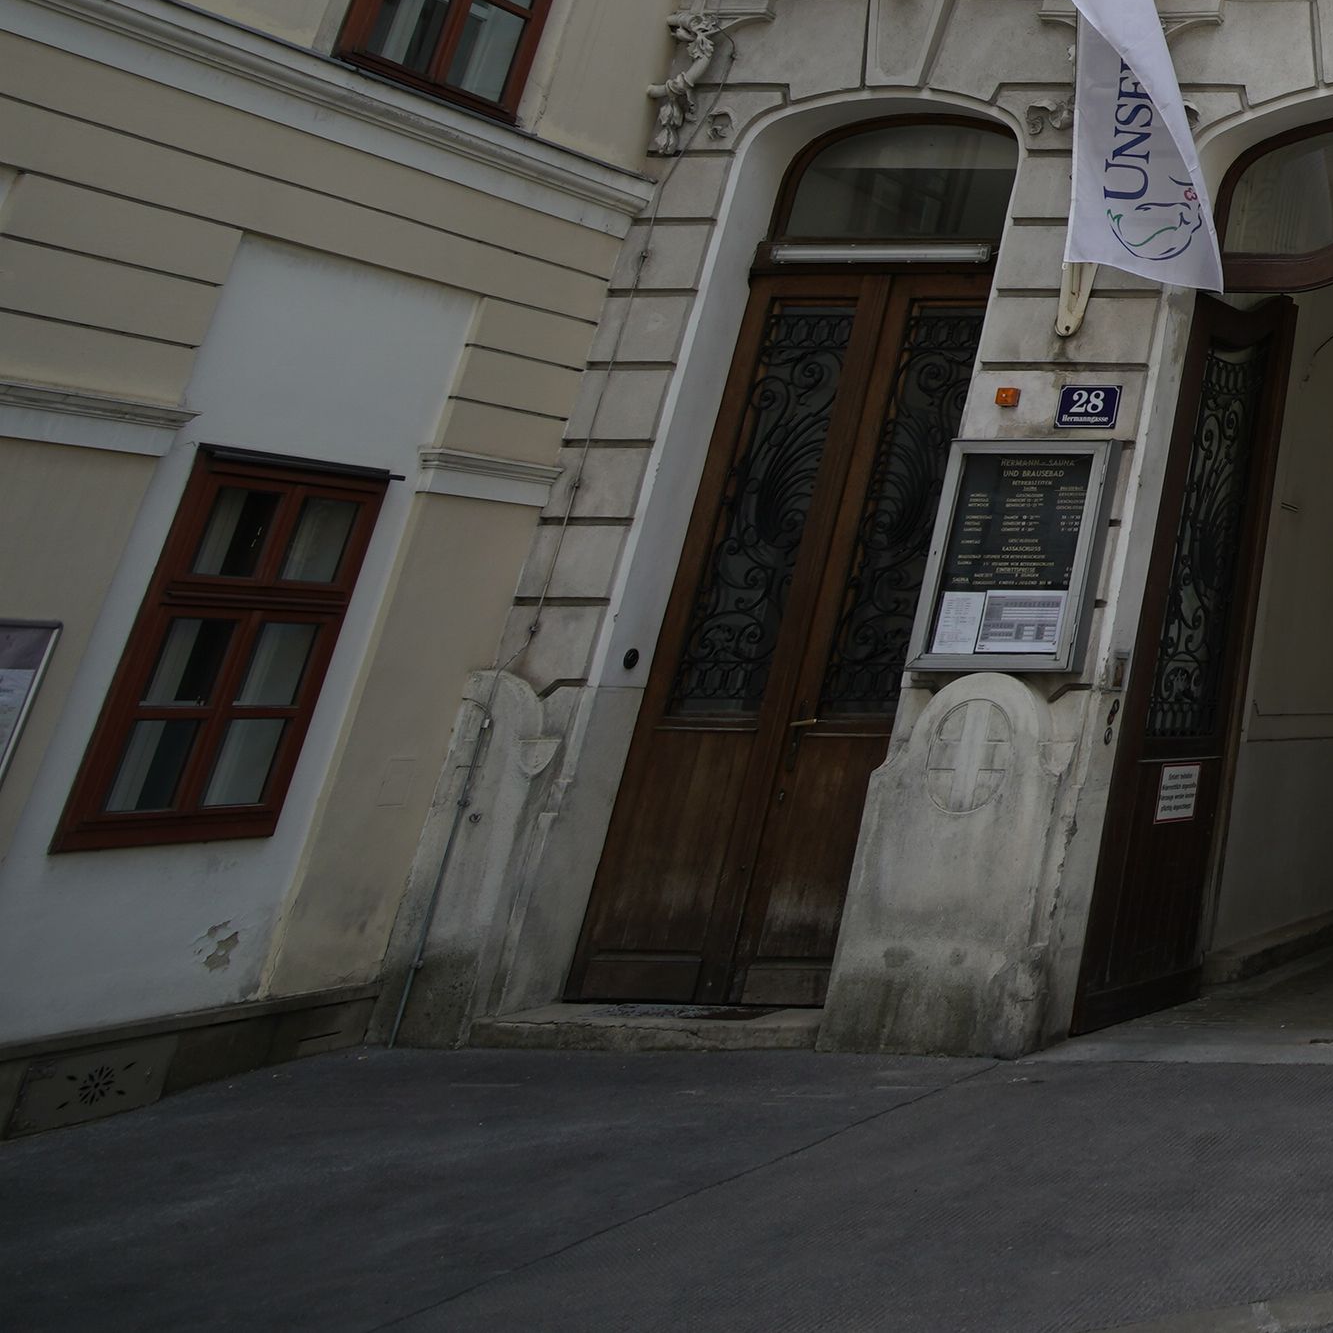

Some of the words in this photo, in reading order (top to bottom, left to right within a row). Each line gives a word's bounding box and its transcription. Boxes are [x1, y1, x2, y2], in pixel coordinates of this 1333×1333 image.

[1069, 390, 1105, 413] 28
[1061, 414, 1109, 423] Hermanngasse
[1003, 469, 1020, 478] UND
[1022, 469, 1065, 478] BRAUSEBAD
